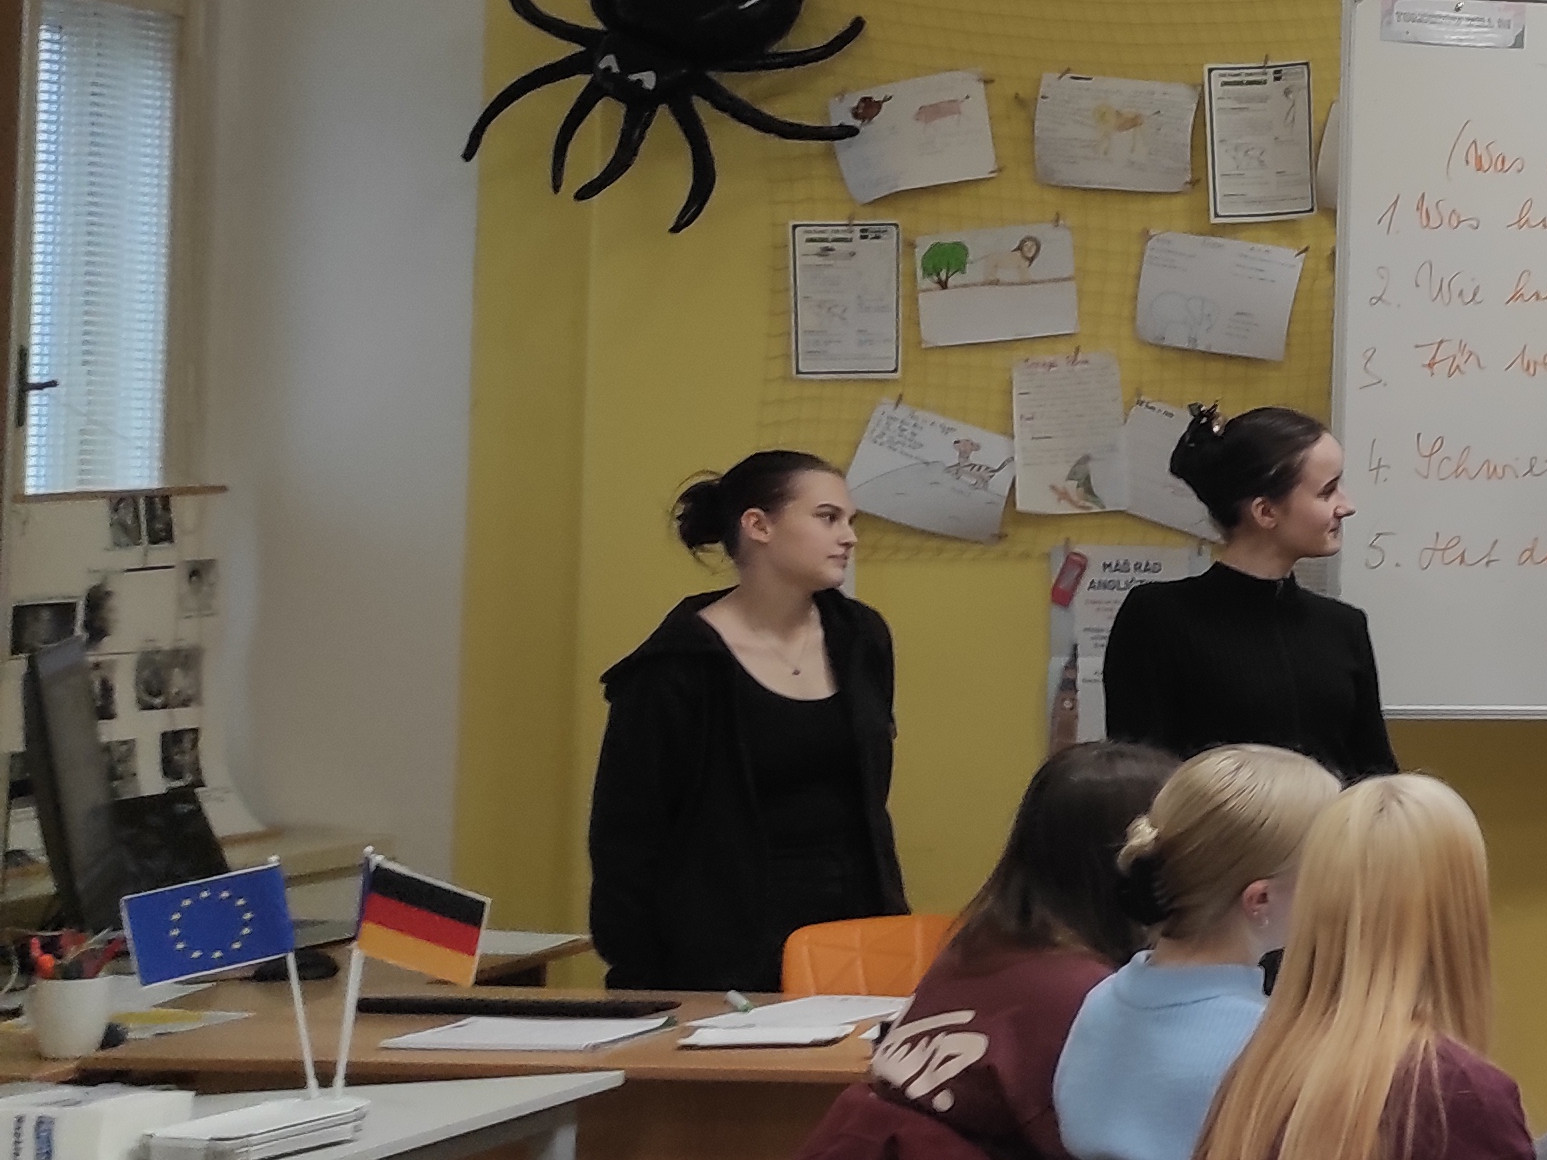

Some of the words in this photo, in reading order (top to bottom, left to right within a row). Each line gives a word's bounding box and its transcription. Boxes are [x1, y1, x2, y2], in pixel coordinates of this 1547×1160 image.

[1416, 192, 1481, 231] Was
[1414, 259, 1484, 306] Wie
[1414, 338, 1485, 379] Für
[1418, 530, 1501, 570] Hat
